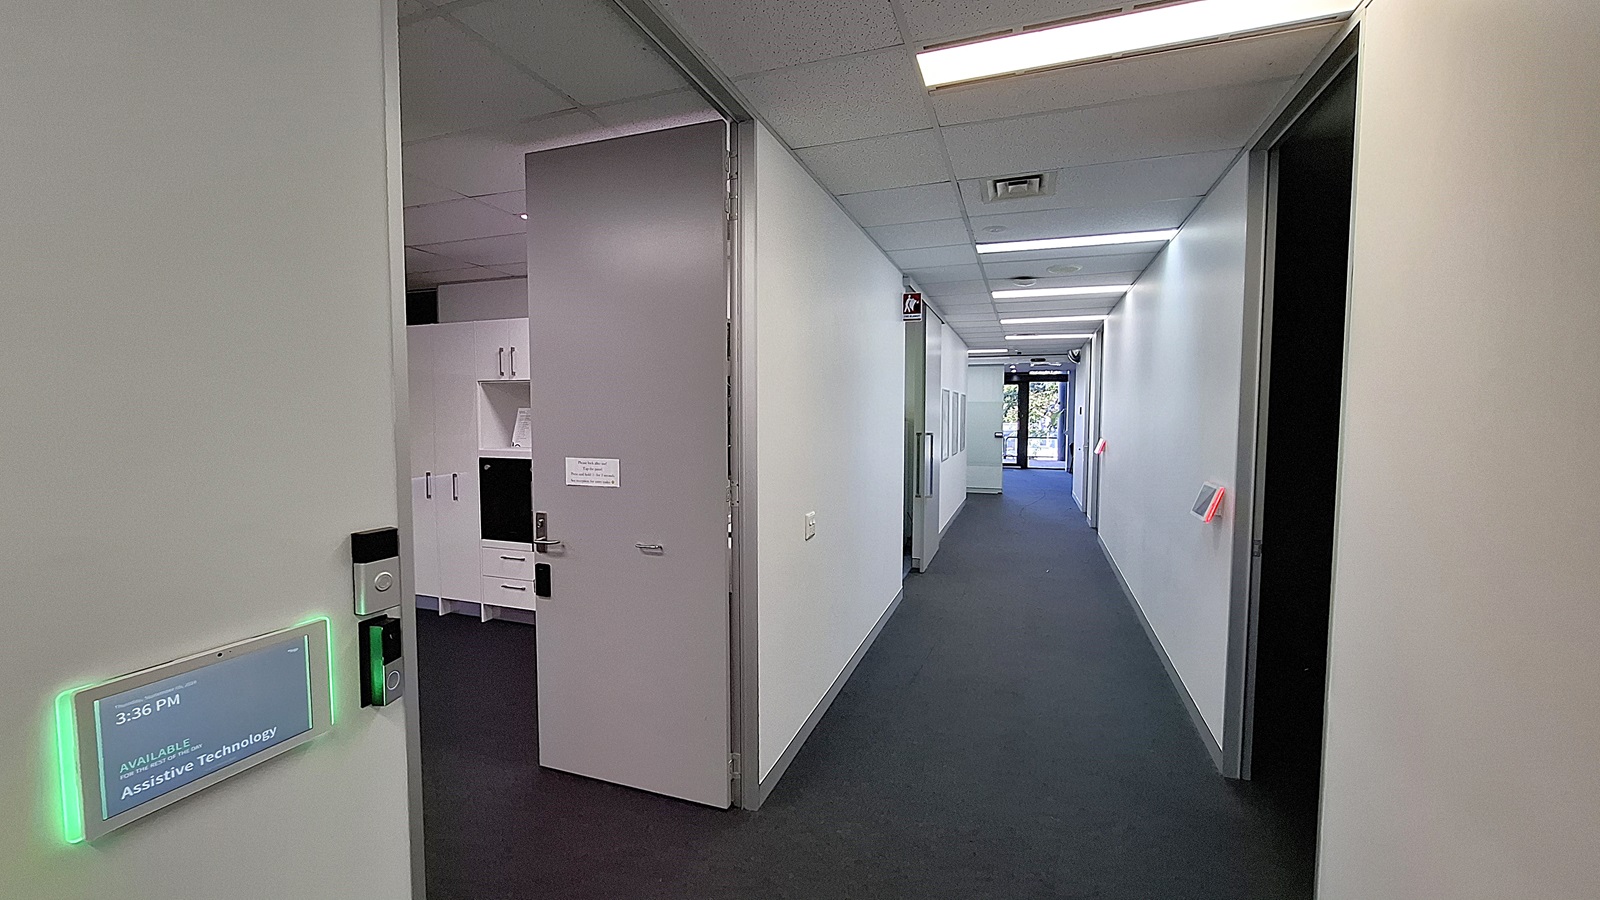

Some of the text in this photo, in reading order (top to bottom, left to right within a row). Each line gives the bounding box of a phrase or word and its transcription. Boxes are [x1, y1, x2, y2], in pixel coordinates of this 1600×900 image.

[115, 703, 152, 725] 3:36
[156, 693, 180, 712] PM
[120, 738, 191, 774] AVAILABLE
[120, 743, 204, 780] FOR THE REST OF THE DAY
[120, 726, 278, 800] Assistive Technology
